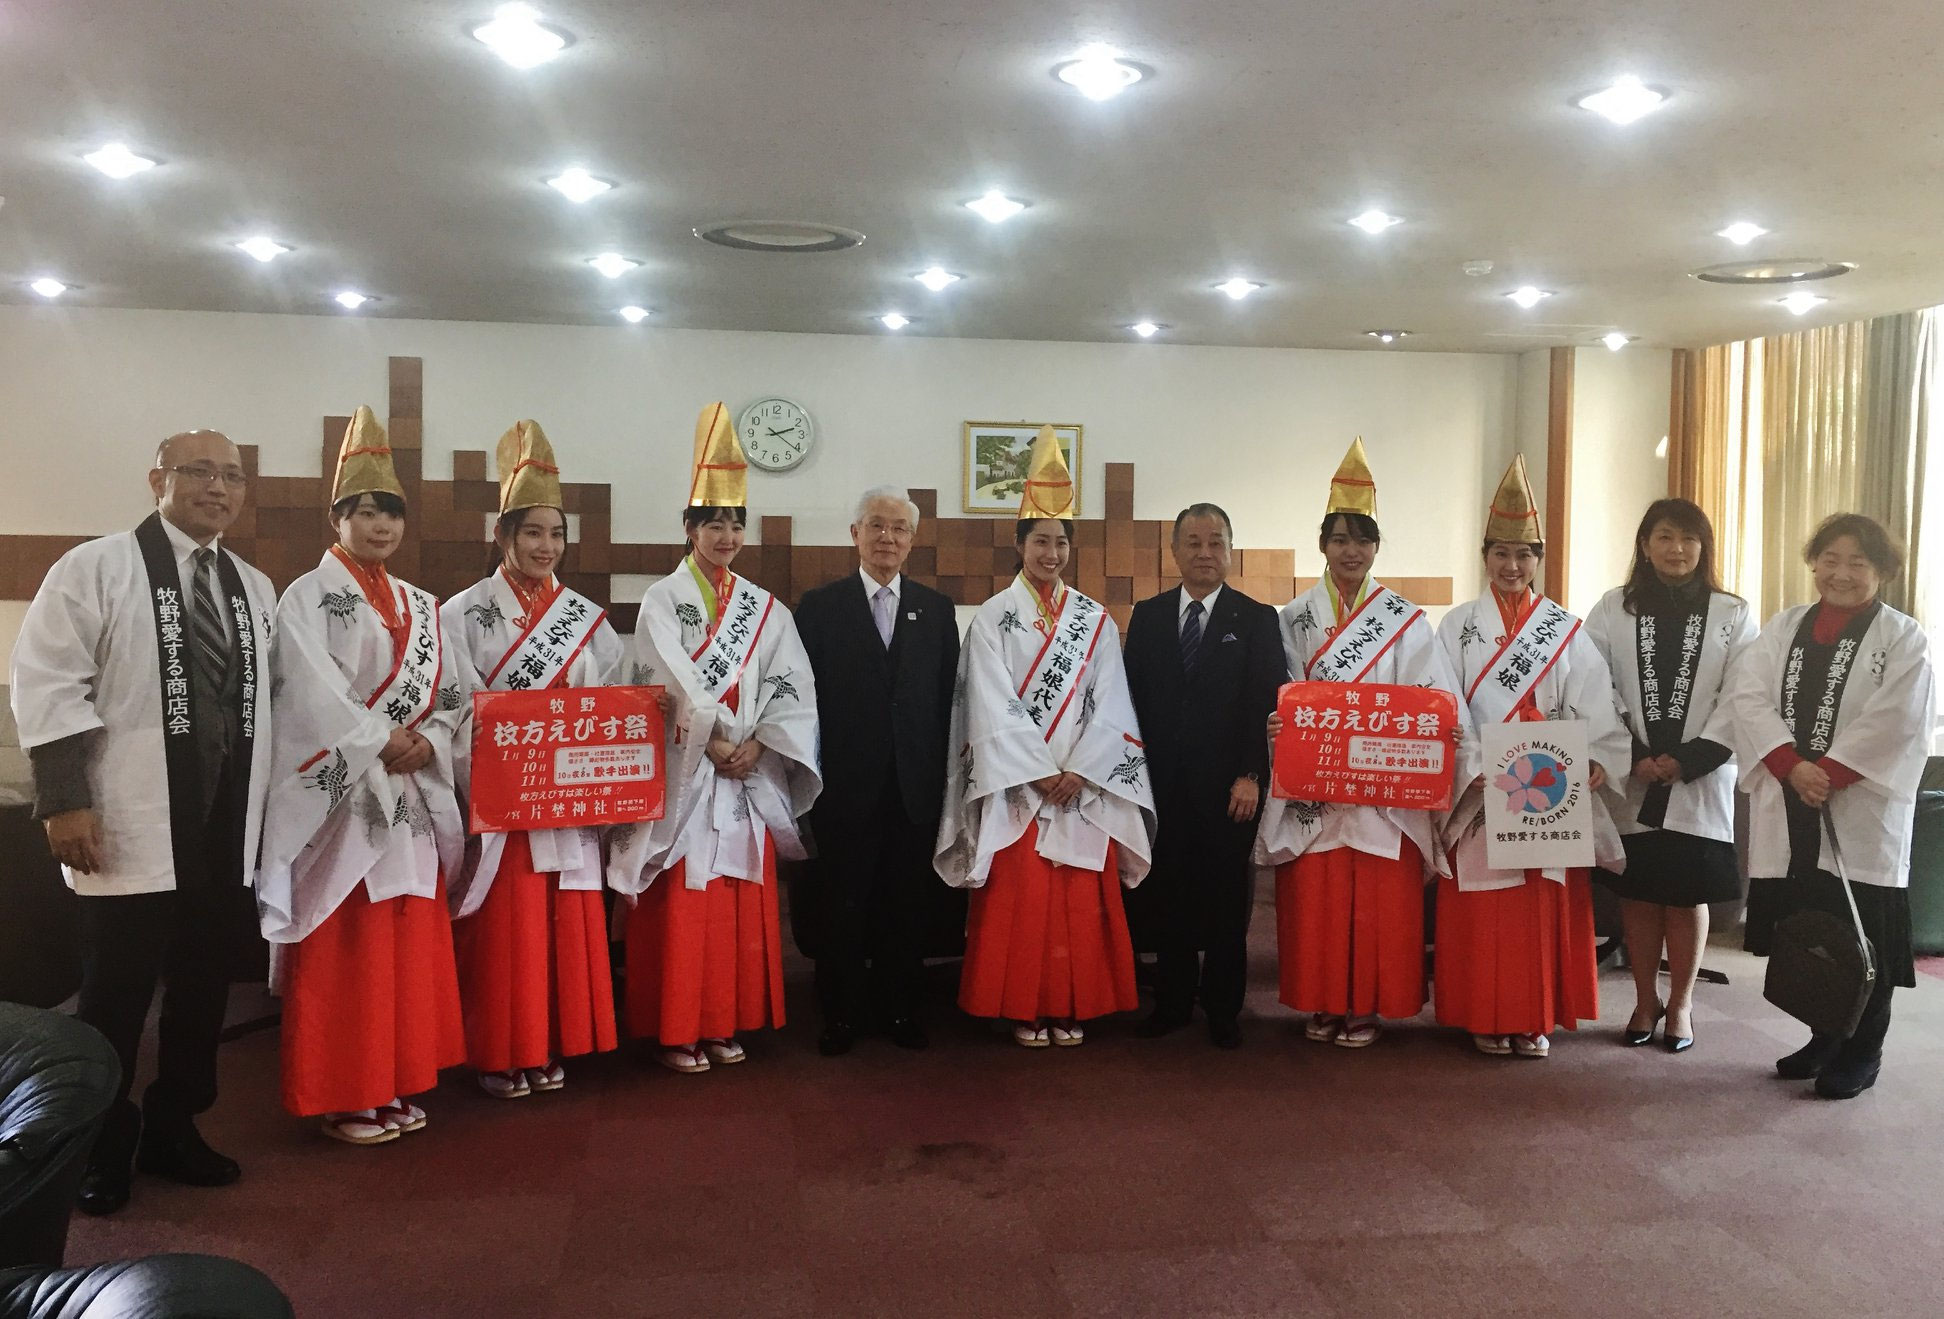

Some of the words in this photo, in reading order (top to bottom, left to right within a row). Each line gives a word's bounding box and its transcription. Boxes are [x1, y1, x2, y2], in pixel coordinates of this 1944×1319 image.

[751, 416, 760, 425] 10
[772, 405, 781, 414] 12
[795, 418, 801, 427] 2
[748, 428, 754, 438] 9
[751, 441, 758, 450] 8
[794, 442, 801, 452] 4
[798, 430, 805, 439] 3
[762, 450, 768, 459] 7
[772, 453, 779, 463] 6
[785, 451, 792, 460] 5
[543, 598, 588, 647] 枚方えびす
[727, 590, 758, 645] 枚方えびす
[1066, 594, 1097, 642] 枚方えびす
[528, 636, 564, 666] 平成31年
[715, 637, 742, 665] 平成31年
[1333, 616, 1385, 670] 枚方えびす
[1516, 637, 1549, 664] 平成31年
[157, 587, 191, 735] 牧野愛する商店会
[231, 596, 256, 738] 牧野愛する商店会
[403, 659, 432, 689] 平成31年
[1495, 652, 1534, 693] 福娘
[1640, 615, 1662, 722] 牧野愛する商店会
[1668, 614, 1703, 720] 牧野愛する商店会
[383, 679, 422, 725] 福娘
[1026, 651, 1072, 727] 福娘代表
[1345, 691, 1389, 707] 牧野
[1810, 638, 1857, 752] 牧野愛する商店会
[550, 697, 596, 714] 牧野
[493, 714, 648, 747] 枚方えびす祭
[1294, 705, 1440, 737] 枚方えびす祭
[1502, 742, 1528, 762] LOVE
[1531, 740, 1574, 766] MAKINO
[1522, 806, 1569, 827] RE/BORN
[1567, 781, 1581, 807] 2016
[1496, 830, 1582, 842] 牧野愛する商店会
